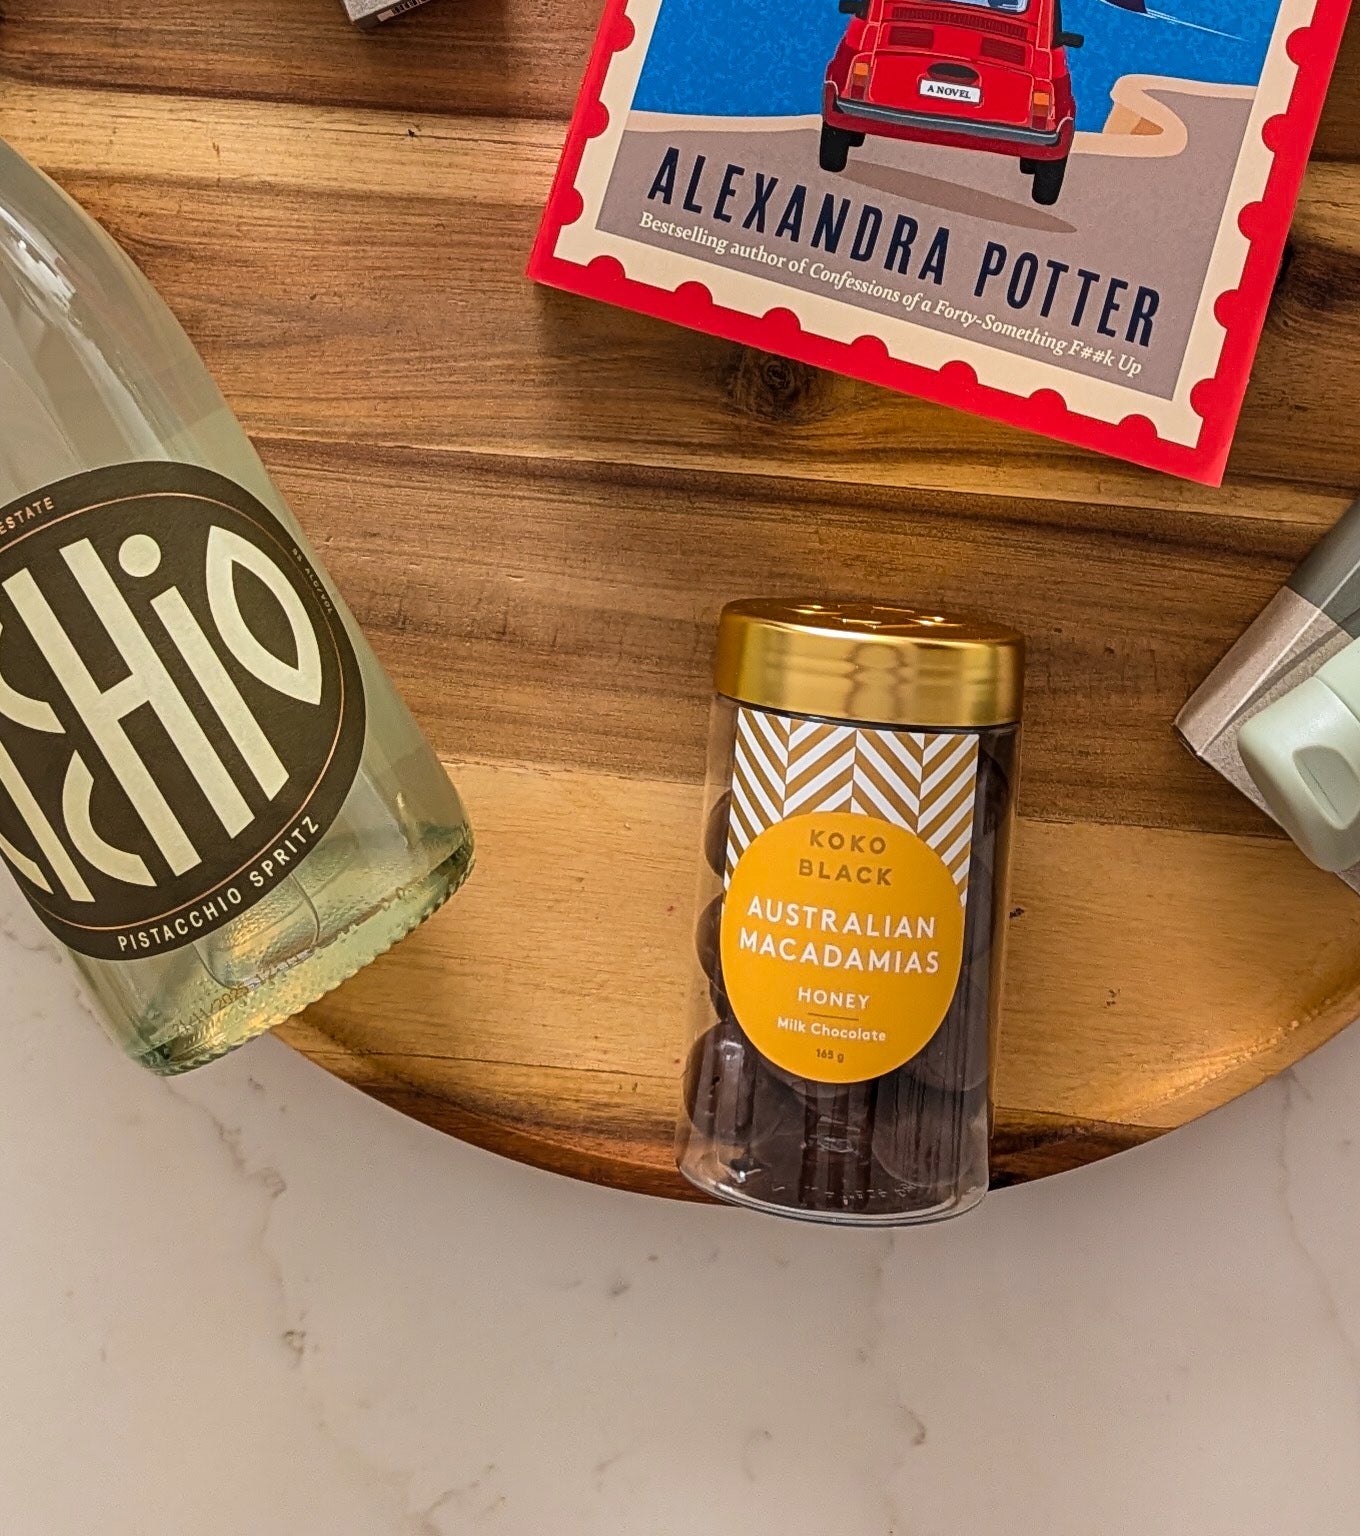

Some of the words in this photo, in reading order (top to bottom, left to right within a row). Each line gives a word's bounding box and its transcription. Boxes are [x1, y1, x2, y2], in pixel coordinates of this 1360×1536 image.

[927, 84, 934, 93] A
[935, 86, 972, 99] NOVEL
[647, 147, 952, 287] ALEXANDRA
[973, 240, 1161, 349] POTTER
[639, 211, 729, 256] Bestselling
[730, 241, 787, 269] author
[788, 258, 810, 275] of
[809, 262, 900, 303] Confessions
[902, 292, 922, 312] of
[921, 300, 932, 313] a
[934, 300, 1068, 356] Forty-Something
[1068, 340, 1116, 367] F##k
[1118, 354, 1143, 378] Up
[809, 828, 887, 856] KOKO
[116, 886, 243, 953] PISTACCHIO
[248, 813, 321, 888] SPRITZ
[798, 858, 893, 887] BLACK
[746, 894, 936, 940] AUSTRALIAN
[739, 926, 940, 975] MACADAMIAS
[797, 986, 871, 1010] HONEY
[776, 1015, 806, 1034] Milk
[810, 1021, 888, 1042] Chocolate
[836, 1052, 845, 1064] g
